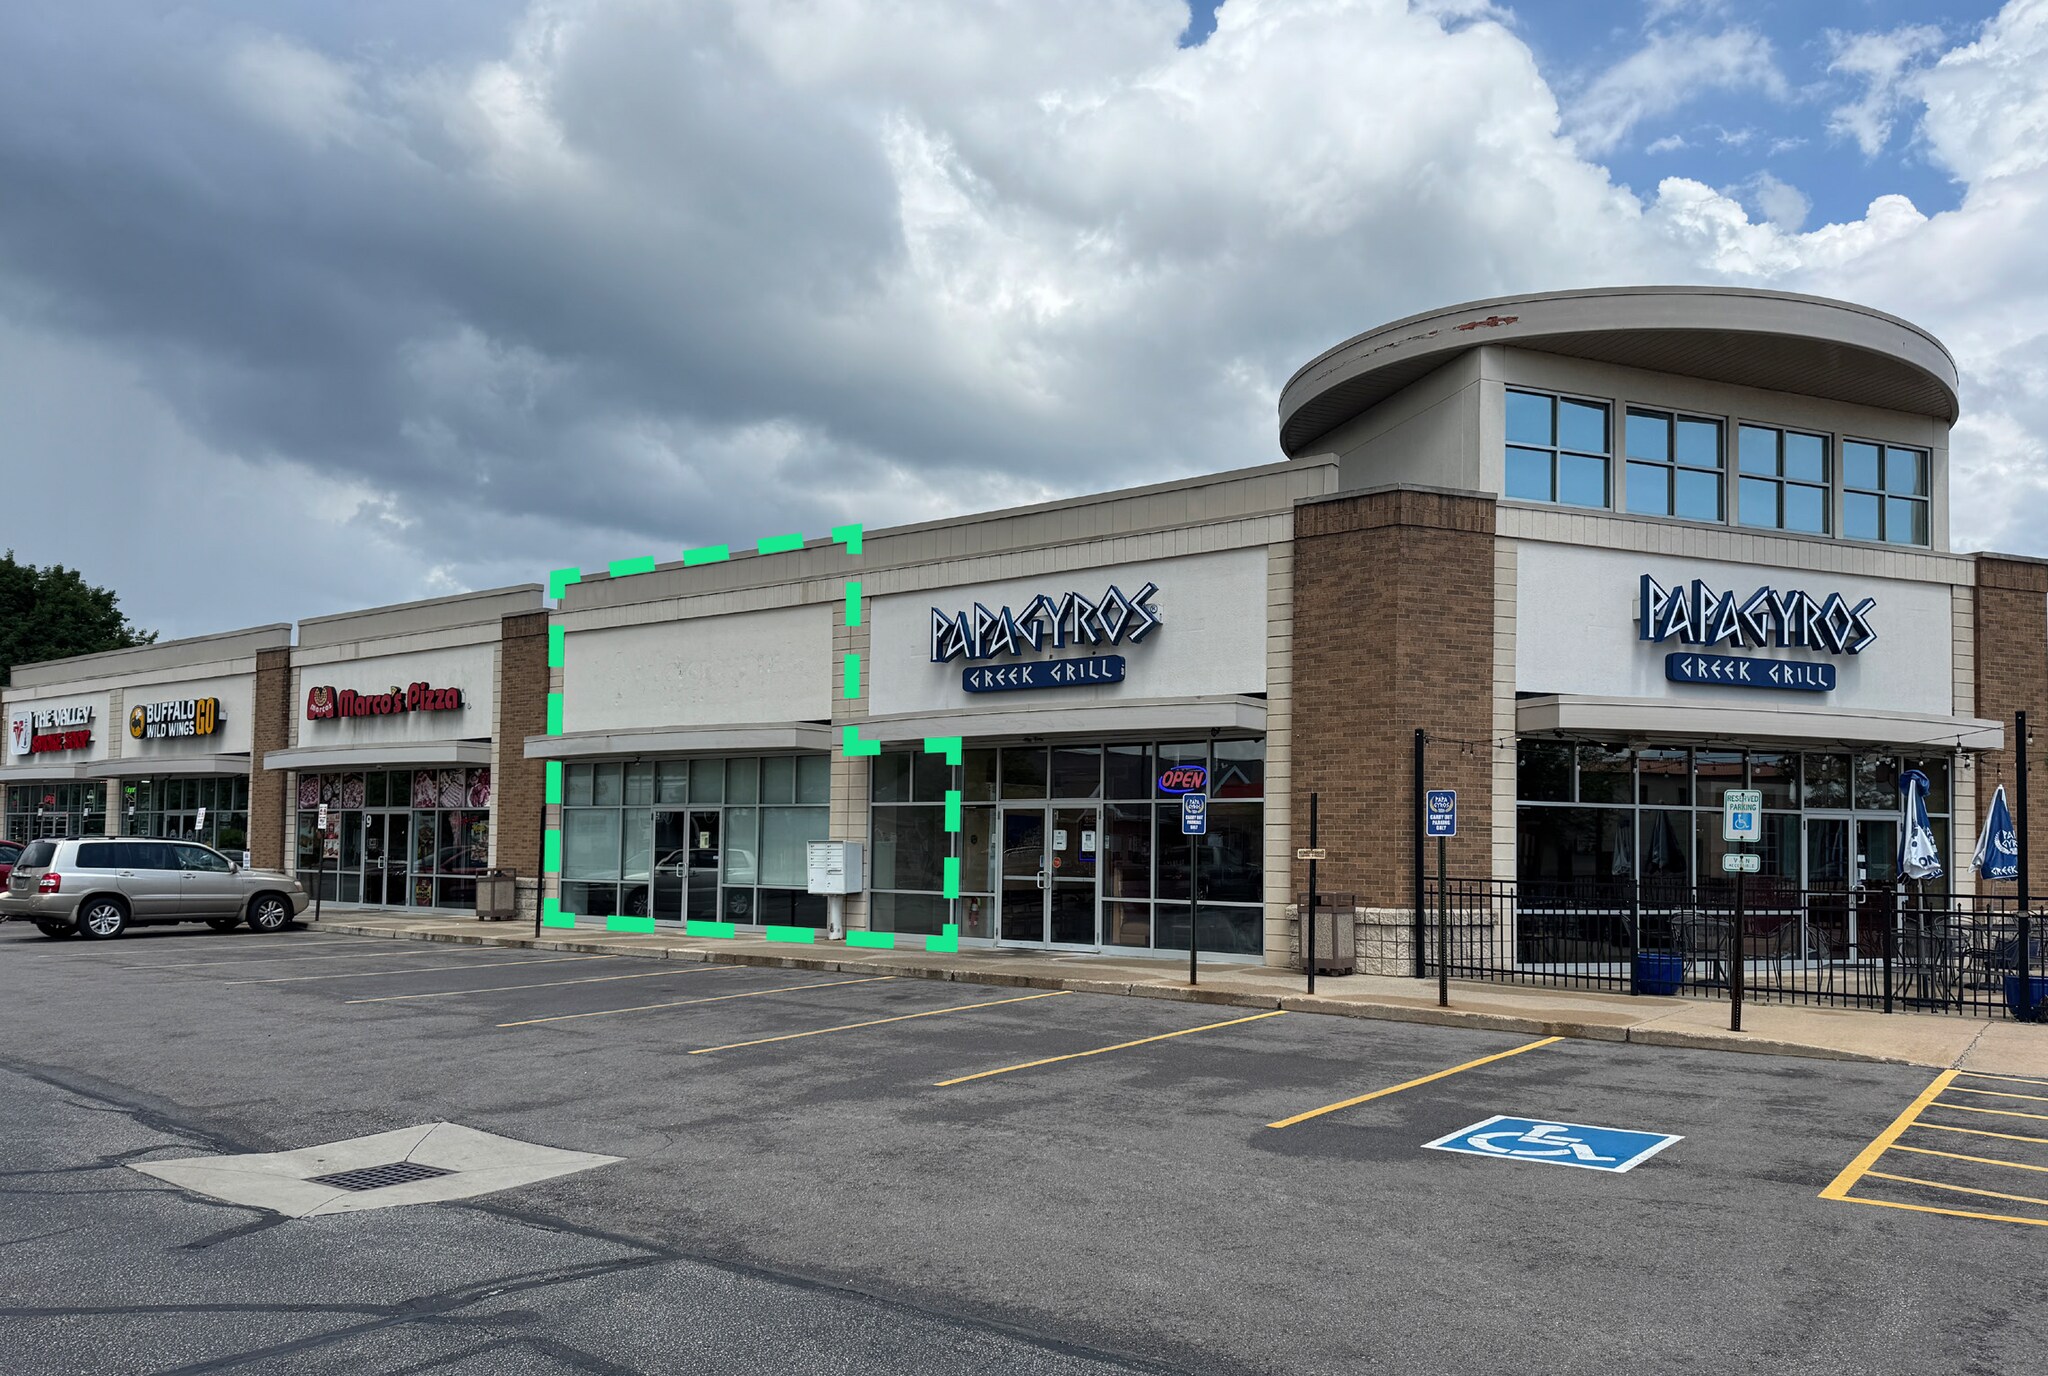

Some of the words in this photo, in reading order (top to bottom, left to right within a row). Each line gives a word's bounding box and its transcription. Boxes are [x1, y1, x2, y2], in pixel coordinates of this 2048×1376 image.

[930, 582, 1157, 663] PAPAGYROS
[1640, 574, 1877, 655] PAPAGYROS
[969, 665, 1034, 689] GREEK
[1050, 659, 1112, 683] GRILL
[1680, 656, 1751, 682] GREEK
[1768, 663, 1828, 687] GRILL
[146, 700, 195, 723] BUFFALO
[338, 687, 402, 718] Marco's
[407, 682, 458, 711] Pizza
[33, 711, 52, 728] THE
[53, 706, 90, 726] VALLEY
[196, 697, 215, 735] GO
[146, 724, 166, 738] WILD
[168, 721, 195, 736] WINGS
[1162, 770, 1204, 788] OPEN
[1729, 803, 1757, 811] PARKING
[366, 815, 372, 828] 9
[1990, 865, 2019, 876] GREEK
